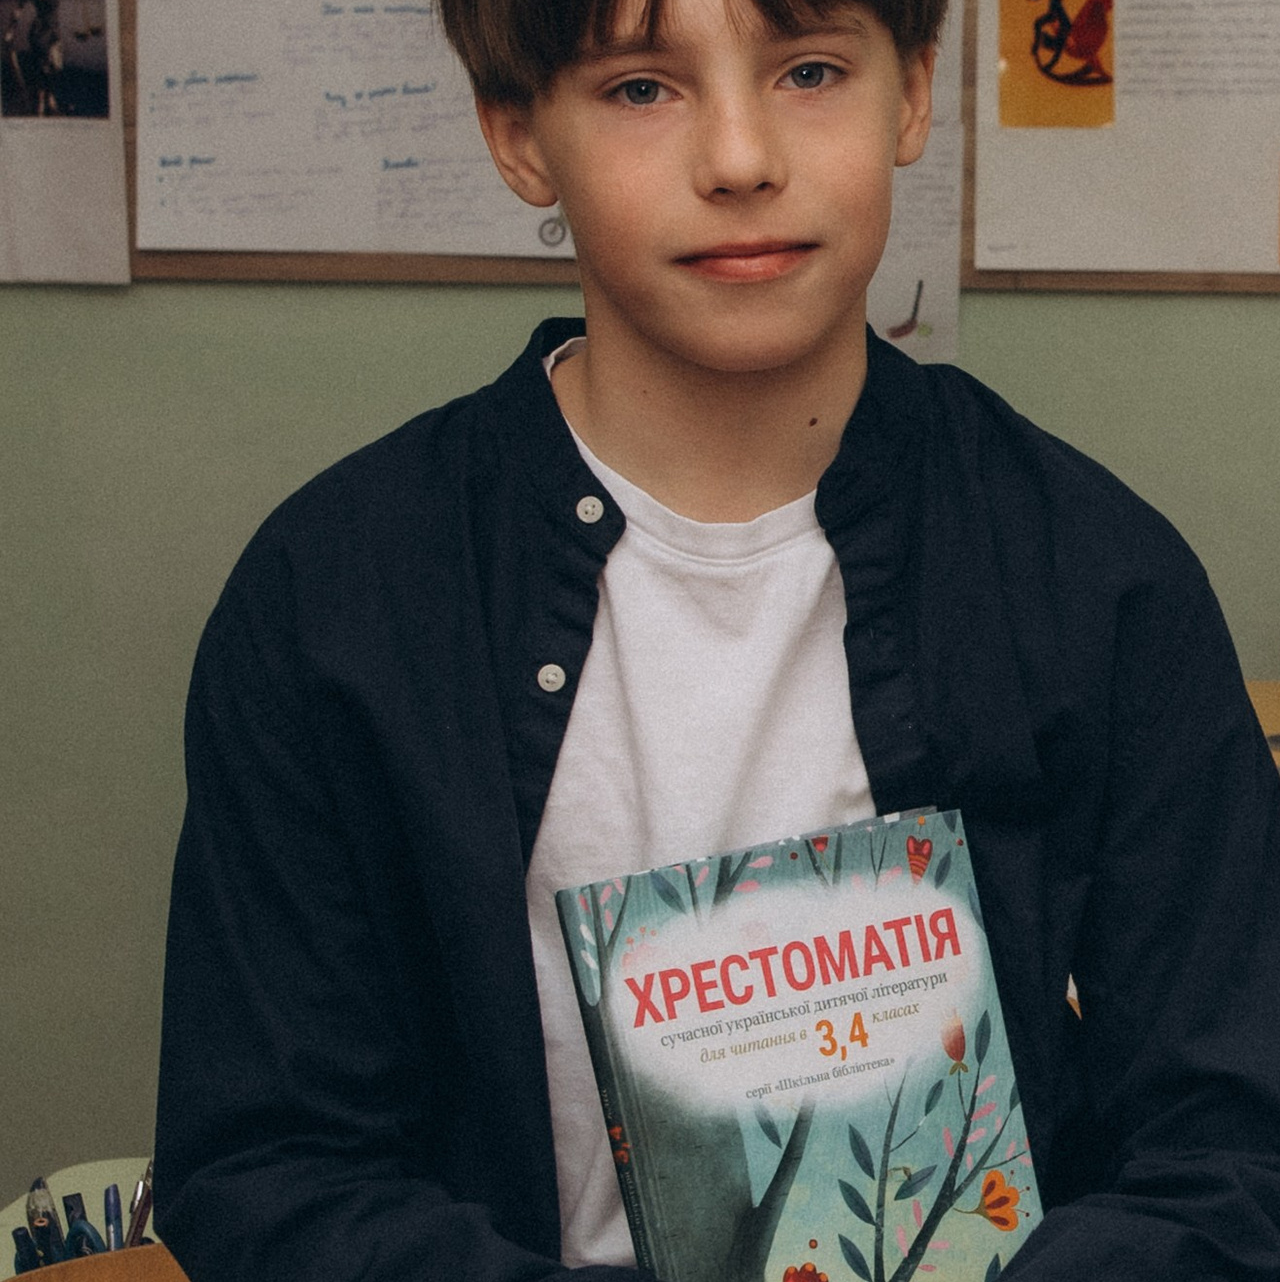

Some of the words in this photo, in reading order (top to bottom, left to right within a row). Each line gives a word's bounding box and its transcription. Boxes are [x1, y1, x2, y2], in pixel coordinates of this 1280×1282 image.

[624, 907, 962, 1028] ХРЕСТОМАТІЯ
[660, 1020, 724, 1049] сучасної
[725, 1000, 811, 1036] української
[813, 988, 869, 1014] дитячої
[871, 972, 949, 1000] літератури
[700, 1047, 727, 1064] для
[729, 1030, 797, 1056] читання
[799, 1028, 808, 1041] в
[815, 1011, 868, 1061] 3,4
[872, 1002, 921, 1024] класах
[745, 1083, 773, 1100] серії
[832, 1056, 896, 1079] бібліотека»
